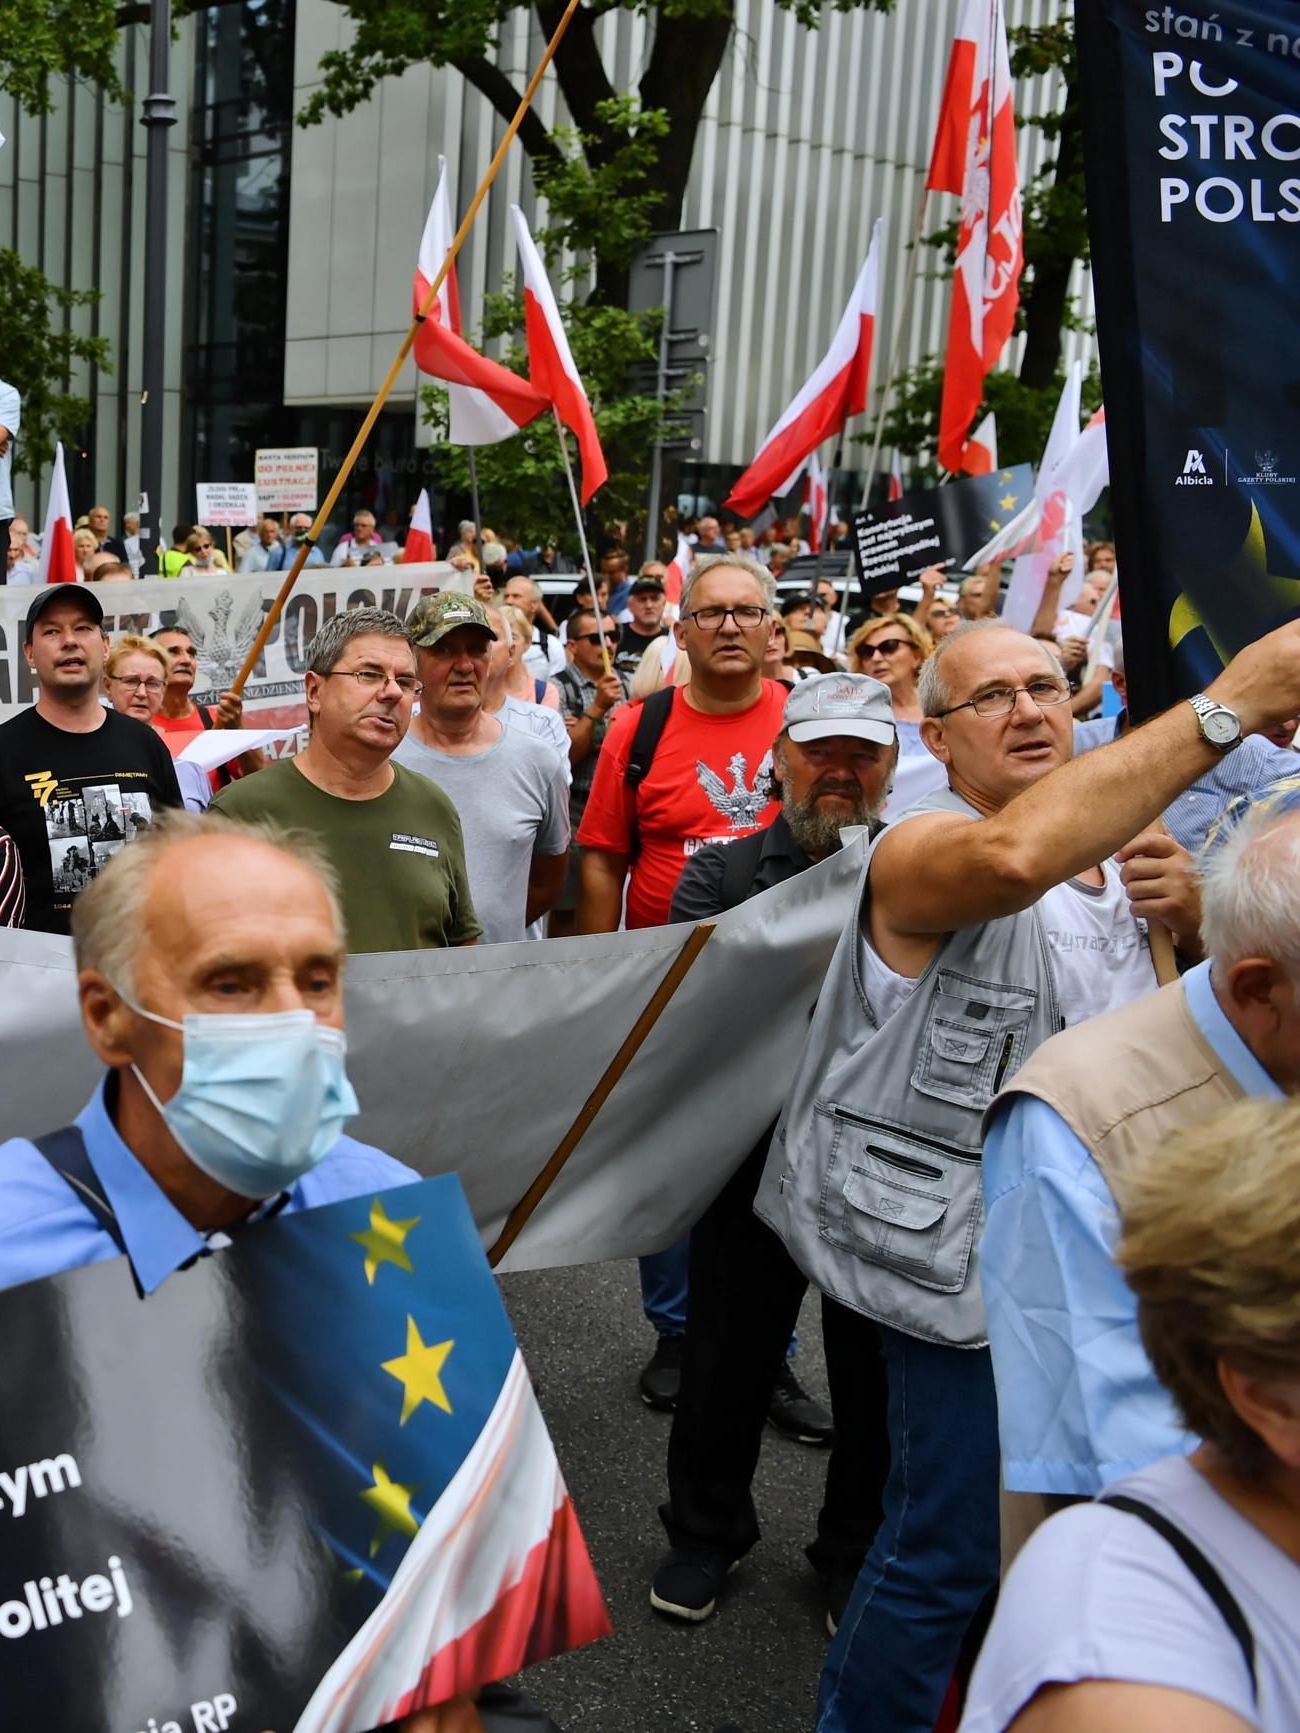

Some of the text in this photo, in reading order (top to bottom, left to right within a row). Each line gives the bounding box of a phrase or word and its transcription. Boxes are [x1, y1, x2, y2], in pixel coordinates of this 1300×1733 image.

[1145, 6, 1223, 42] stań
[1236, 28, 1254, 48] z
[1158, 114, 1300, 161] STRO
[1160, 176, 1300, 223] POLS
[1175, 476, 1213, 485] Albicla
[262, 681, 306, 697] DZIENNI
[190, 1693, 238, 1733] RP
